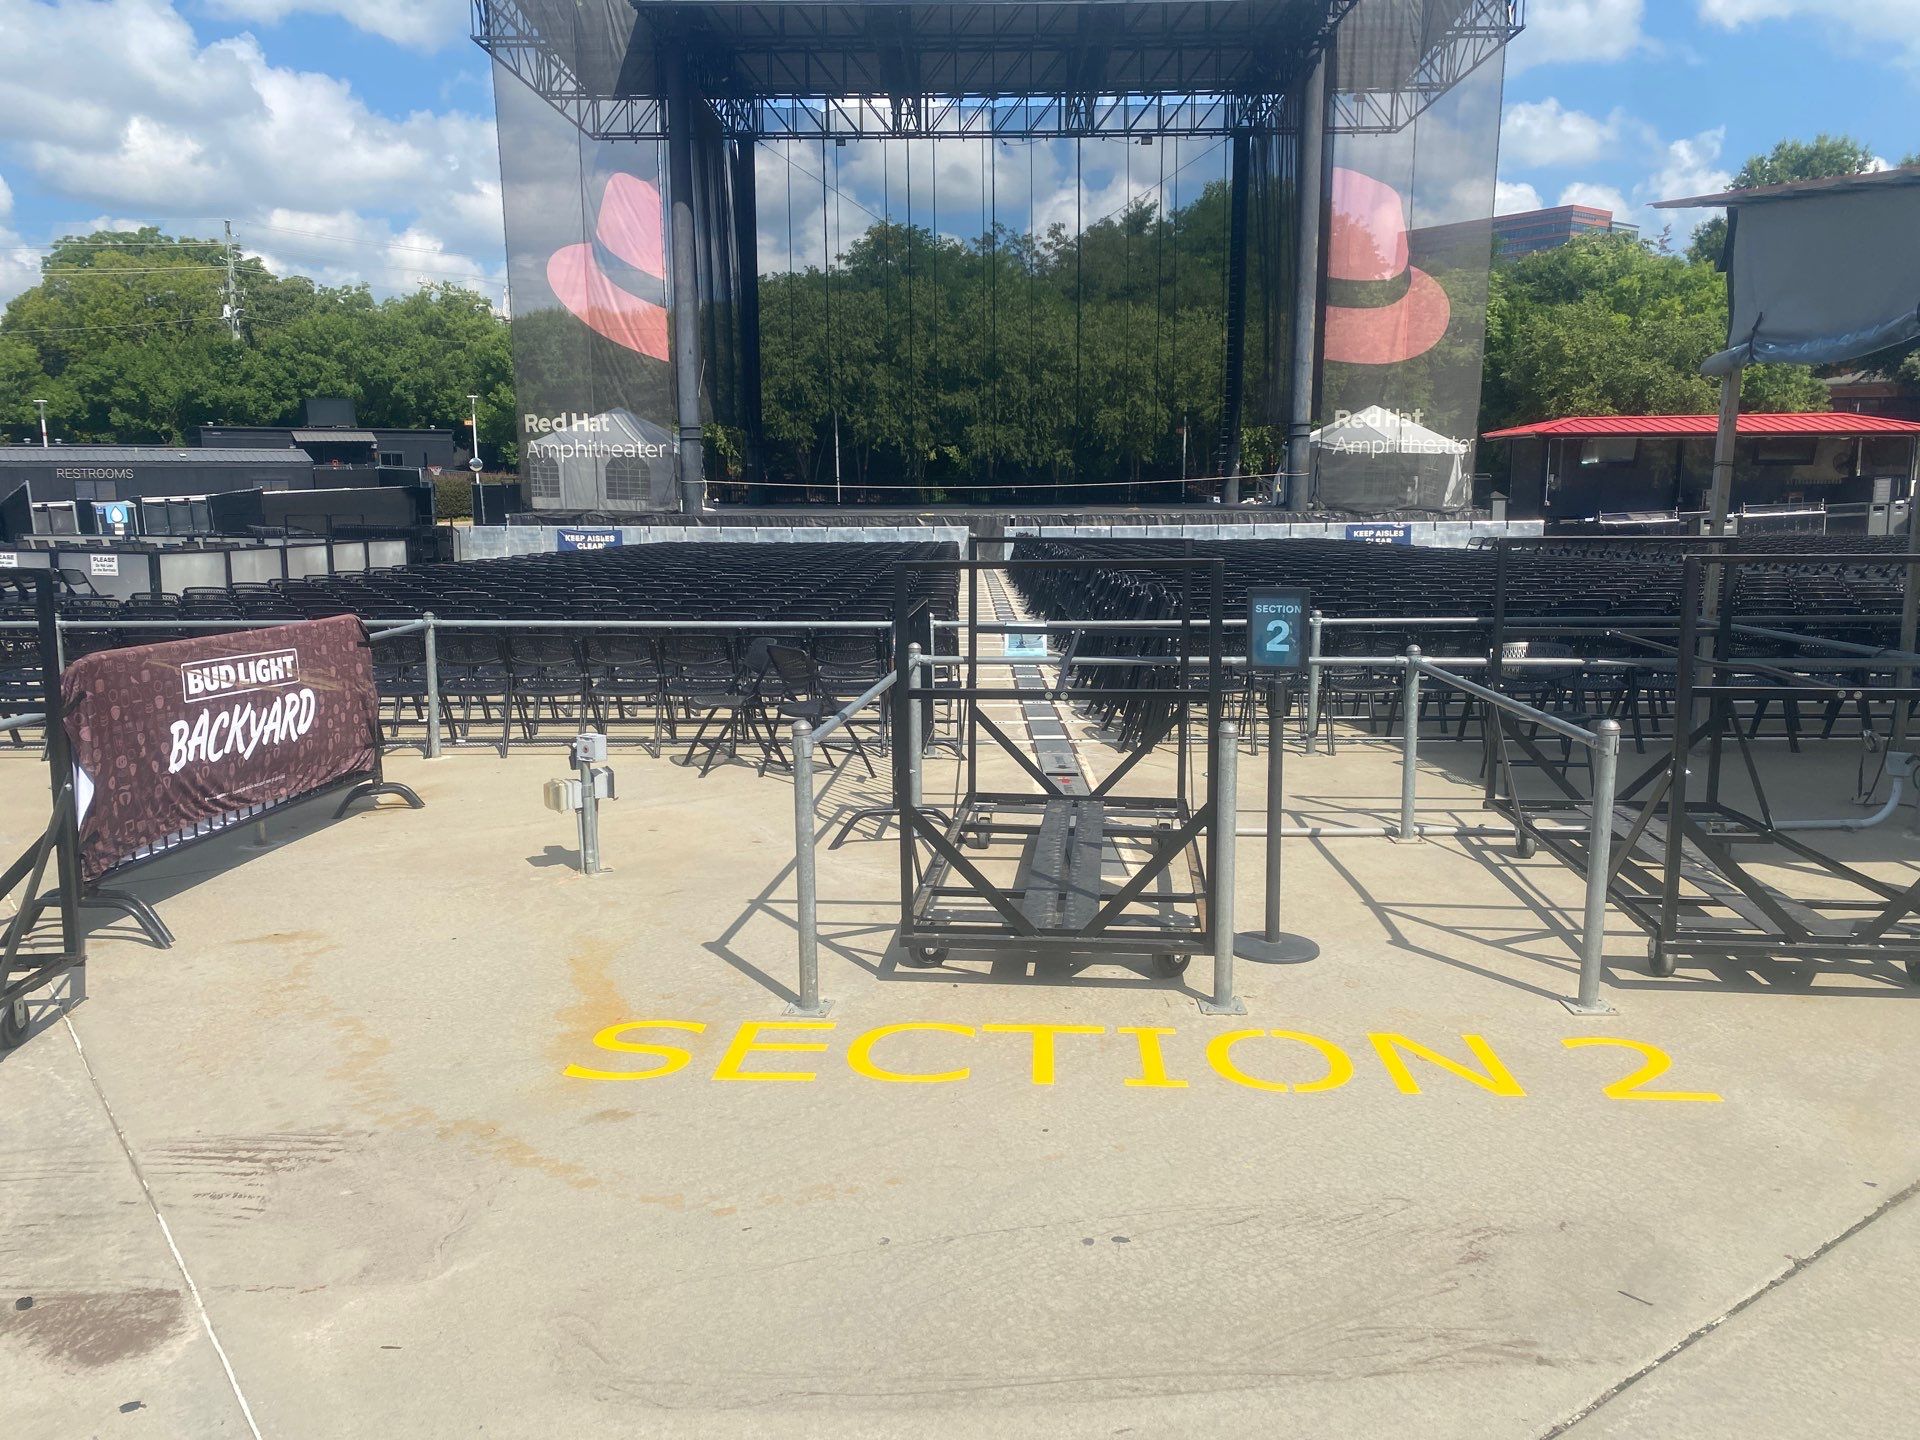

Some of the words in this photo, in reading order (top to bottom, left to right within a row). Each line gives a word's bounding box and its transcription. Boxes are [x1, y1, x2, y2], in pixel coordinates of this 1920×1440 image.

[524, 412, 567, 432] Red
[571, 412, 610, 432] Hat
[1334, 408, 1381, 428] Red
[1384, 408, 1425, 428] Hat
[526, 439, 667, 463] Amphitheater
[1332, 435, 1475, 459] Amphitheater
[56, 468, 134, 479] RESTROOMS
[565, 534, 585, 542] KEEP
[586, 534, 616, 542] AISLES
[577, 542, 604, 550] CLEAR
[1255, 604, 1302, 613] SECTION
[1266, 620, 1290, 651] 2
[186, 664, 236, 694] BUD
[237, 656, 294, 684] LIGHT
[168, 688, 316, 774] BACKYARD
[563, 1020, 1527, 1096] SECTION
[1560, 1036, 1725, 1102] 2
